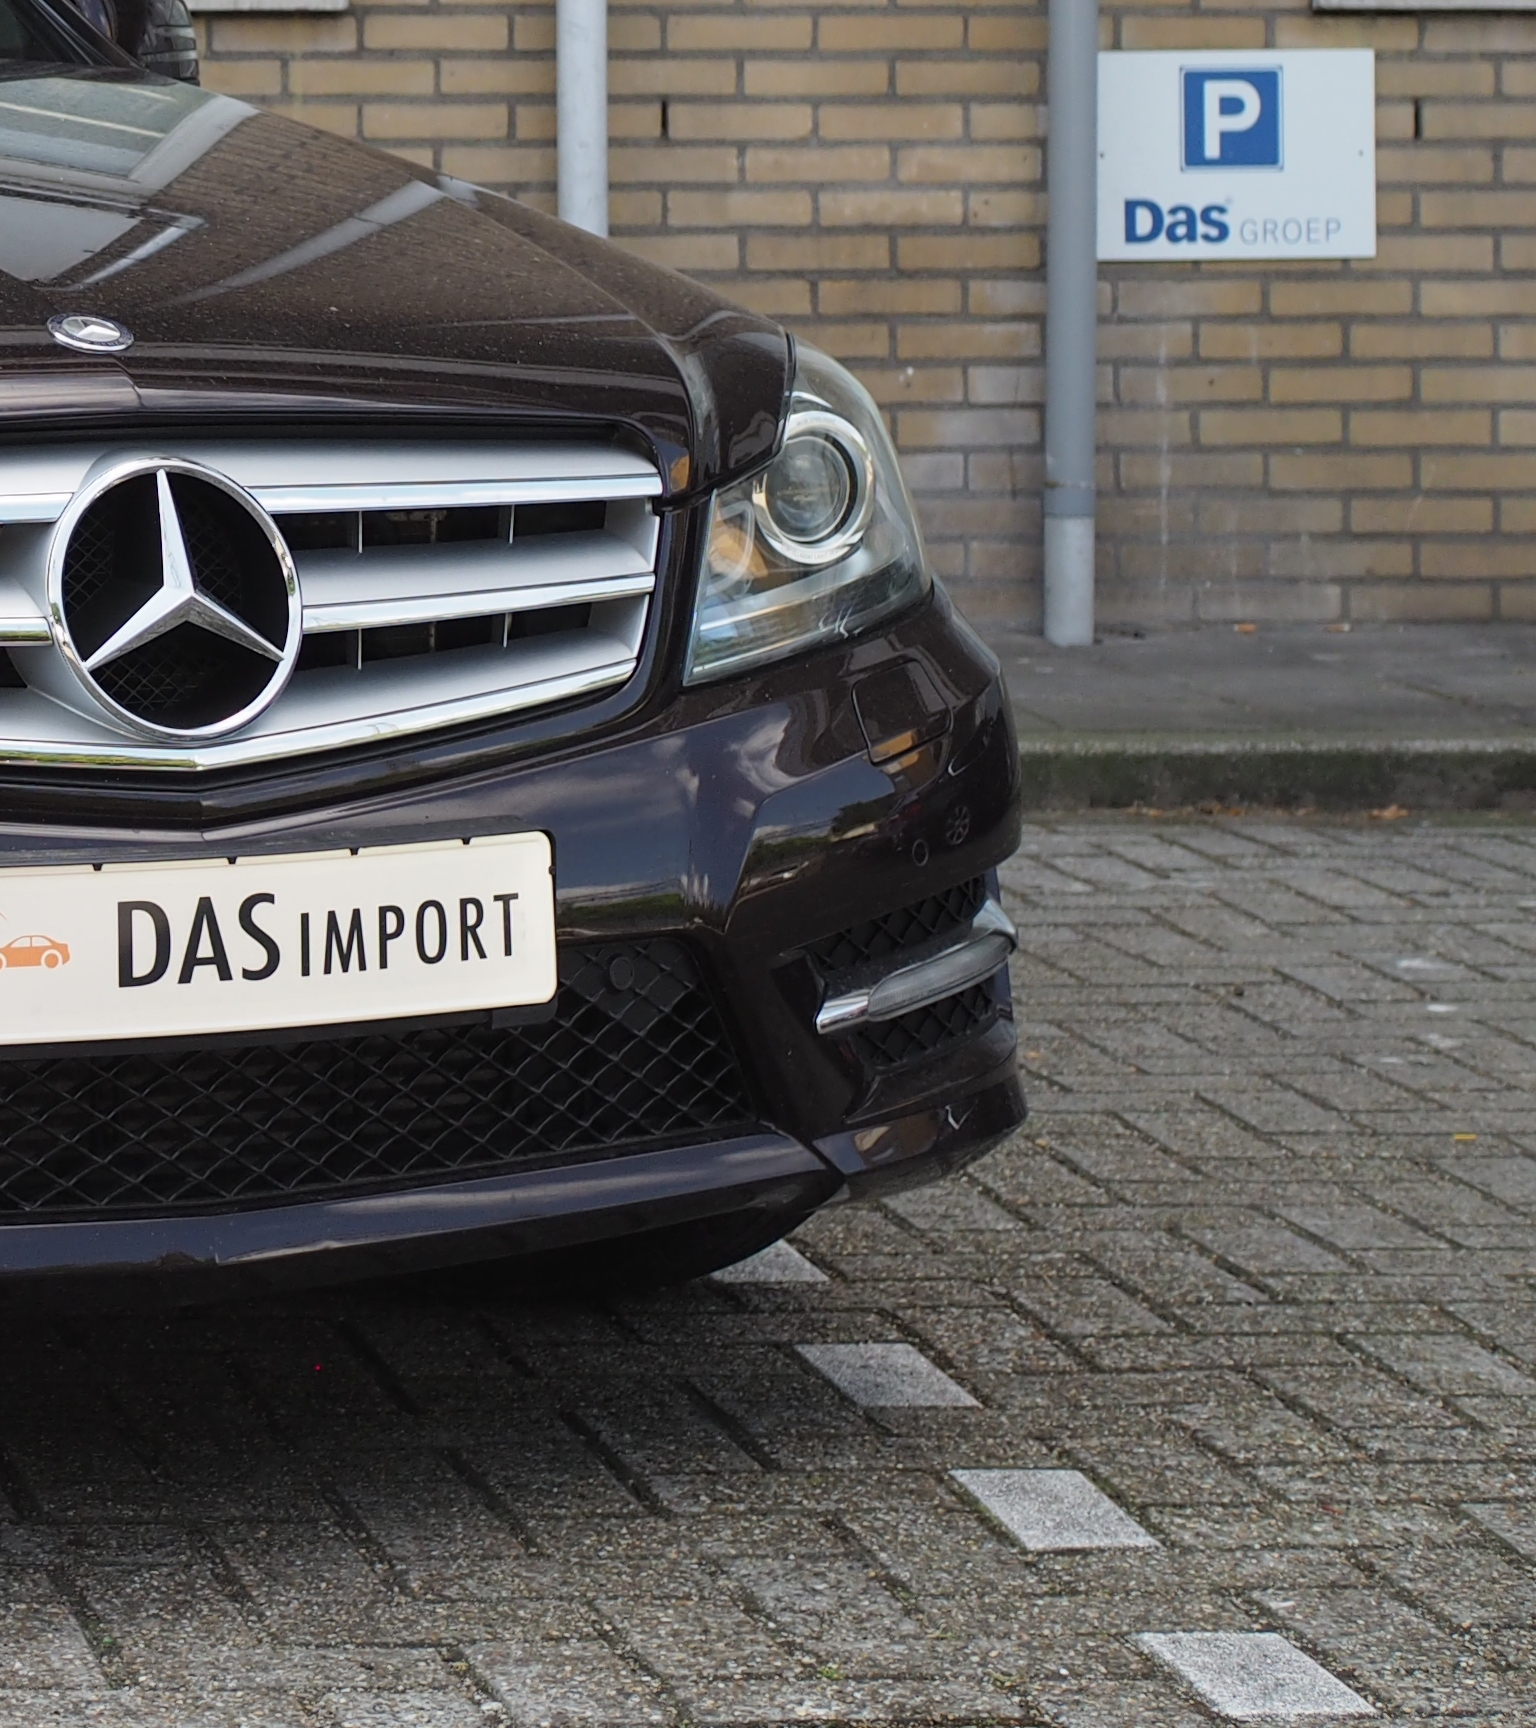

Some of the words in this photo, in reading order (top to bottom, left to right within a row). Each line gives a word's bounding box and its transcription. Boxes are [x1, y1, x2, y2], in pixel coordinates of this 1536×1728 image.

[1203, 80, 1261, 159] P
[1123, 198, 1230, 245] Das
[1239, 217, 1342, 245] GROEP
[117, 892, 281, 988] DAS
[300, 892, 520, 977] IMPORT
